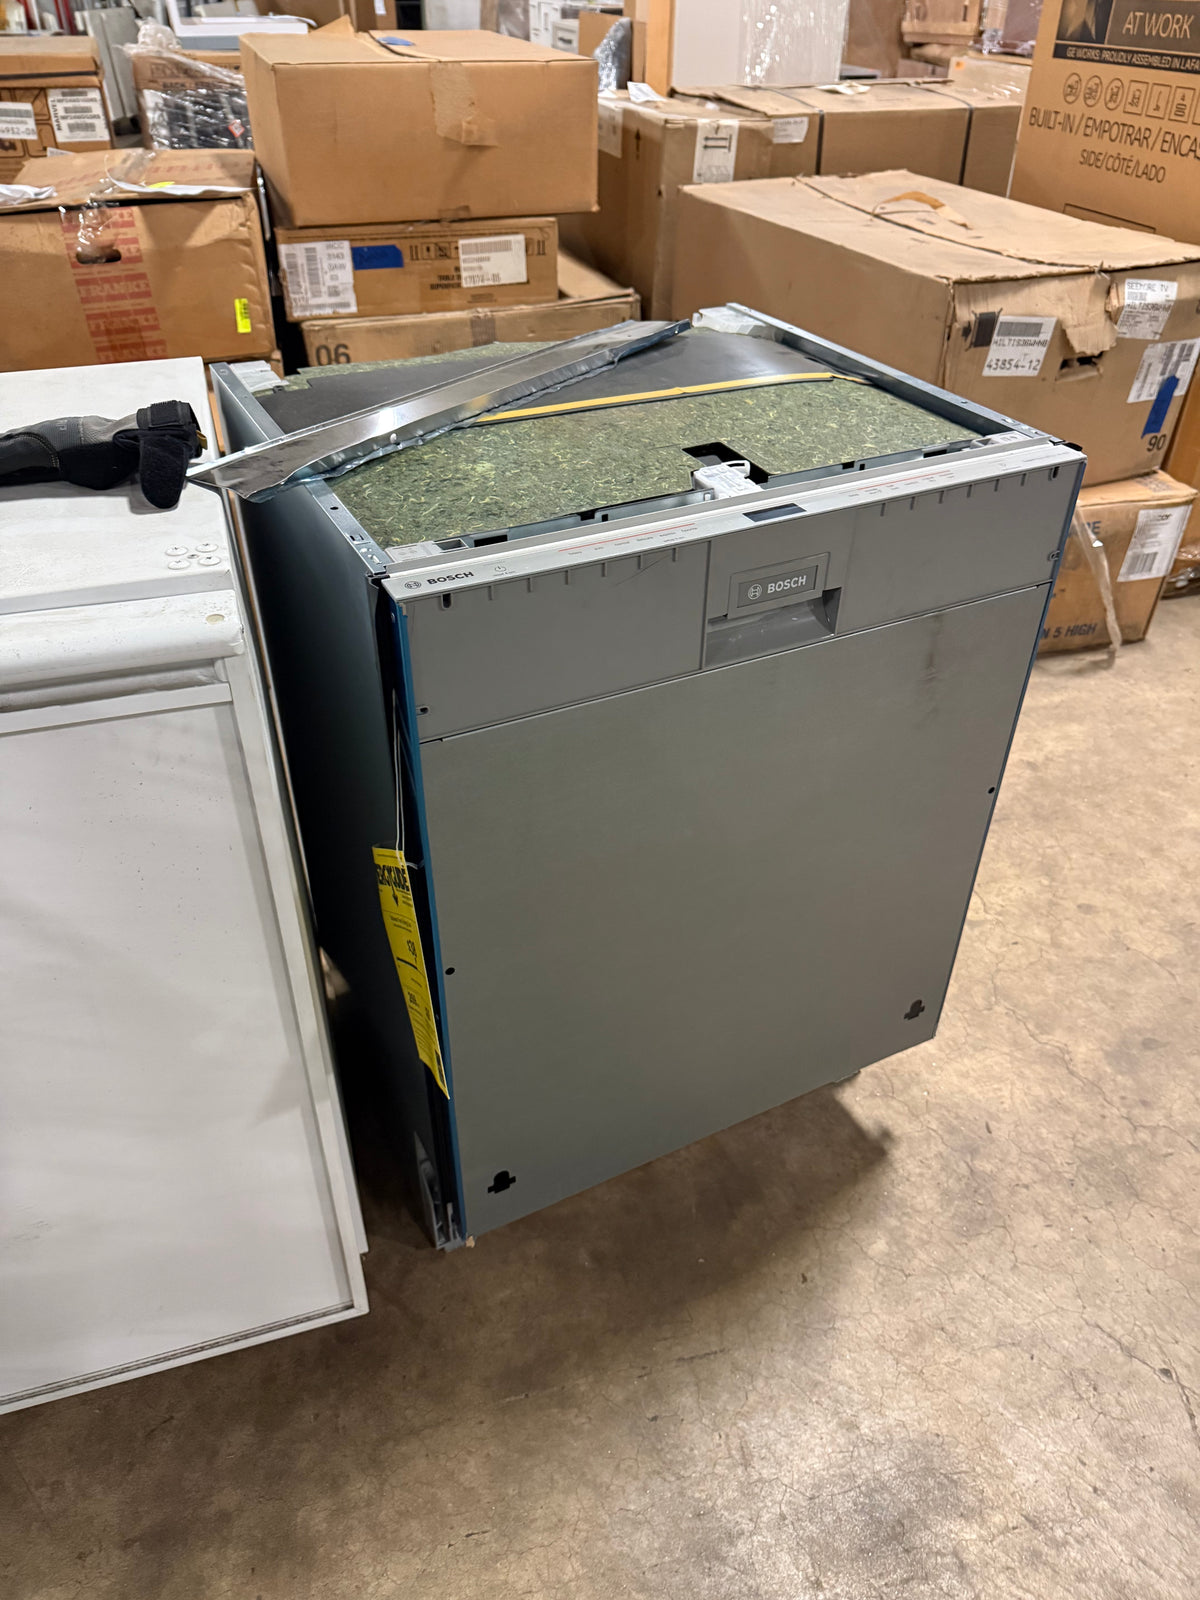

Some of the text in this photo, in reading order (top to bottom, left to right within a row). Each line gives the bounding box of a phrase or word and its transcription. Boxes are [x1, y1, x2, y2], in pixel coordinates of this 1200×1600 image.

[1122, 11, 1194, 39] AT WORK
[1066, 47, 1078, 58] GE
[1101, 50, 1132, 64] PROUDLY
[1131, 53, 1172, 69] ASSEMBLED
[1171, 57, 1182, 70] IN
[1029, 107, 1076, 134] BUILT-IN
[1083, 116, 1152, 150] EMPOTRAR
[1079, 149, 1166, 183] SIDE/CÔTÉ/LADO
[80, 279, 150, 298] FRANKE
[315, 343, 350, 366] 06
[986, 359, 1040, 371] 43854-12
[1146, 433, 1167, 452] 90
[427, 571, 474, 585] BOSCH
[767, 575, 807, 594] BOSCH
[1064, 622, 1098, 638] HIGH
